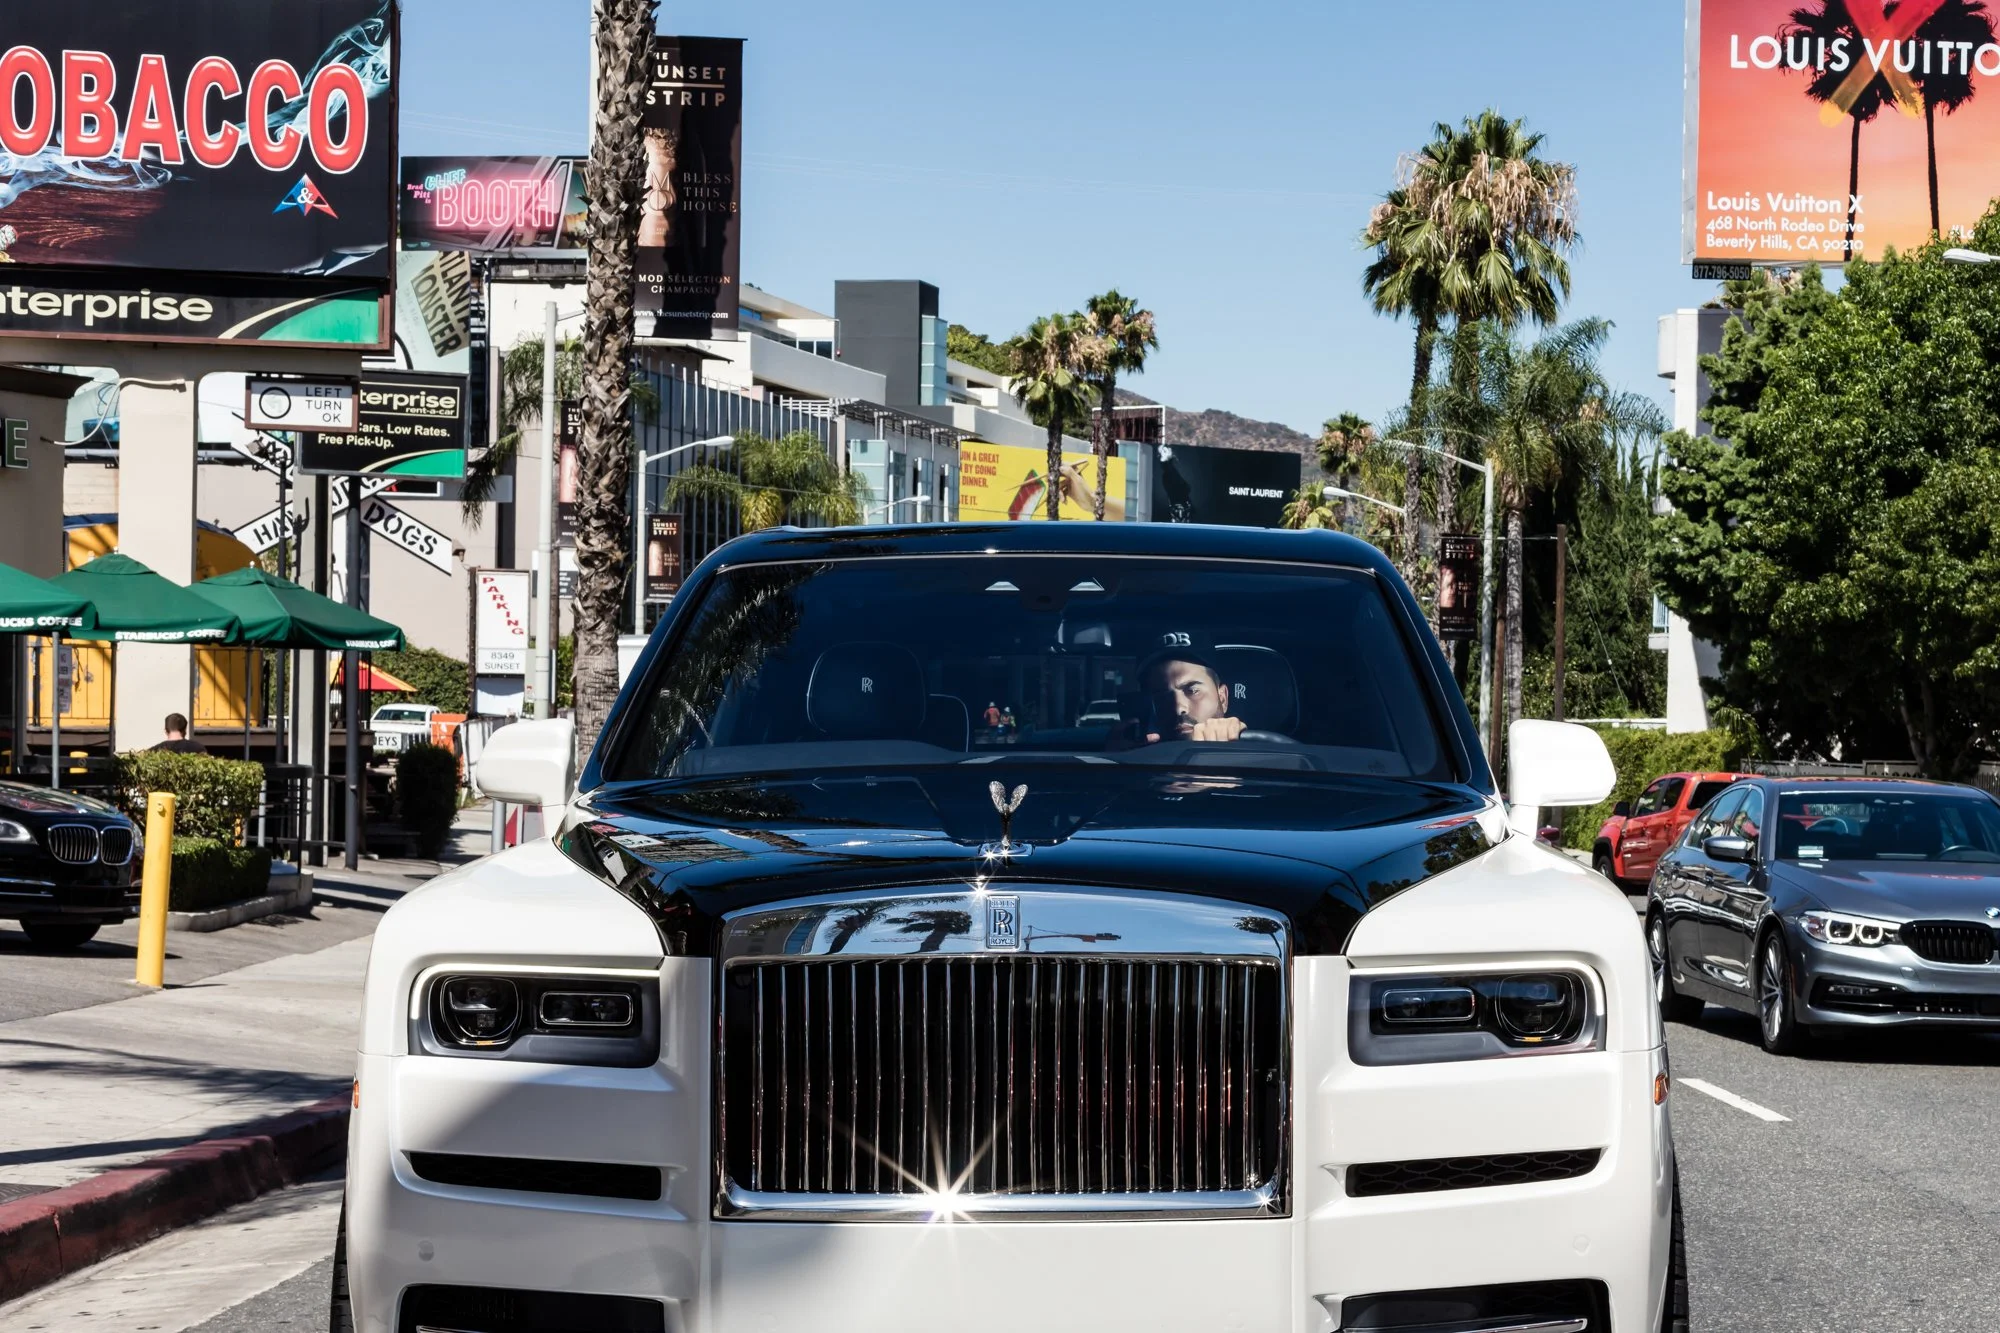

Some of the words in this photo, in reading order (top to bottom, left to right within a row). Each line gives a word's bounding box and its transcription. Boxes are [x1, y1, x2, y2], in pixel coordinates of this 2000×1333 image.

[653, 52, 669, 60] HE
[1730, 34, 1850, 72] LOUIS
[1862, 38, 2000, 76] VUITTO
[657, 65, 726, 80] UNSET
[646, 90, 725, 106] STRIP
[0, 45, 368, 174] OBACCO
[424, 168, 467, 191] CLIFF
[683, 172, 732, 184] BLESS
[413, 190, 431, 199] Pitt
[683, 186, 721, 197] THIS
[436, 180, 555, 227] BOOTH
[683, 200, 737, 212] HOUSE
[1706, 191, 1761, 212] Louis
[1767, 192, 1842, 213] Vuitton
[1848, 194, 1864, 214] X
[1706, 215, 1733, 234] 468
[1736, 216, 1777, 231] North
[1781, 217, 1825, 233] Rodeo
[1829, 219, 1865, 233] Drive
[1706, 233, 1757, 252] Beverly
[1760, 235, 1792, 251] Hills,
[1796, 236, 1819, 250] CA
[1822, 239, 1864, 253] 90210
[1693, 264, 1750, 280] 877-796-5050
[638, 274, 664, 283] MOD
[650, 285, 718, 295] CHAMPAGNE
[305, 386, 343, 398] LEFT
[307, 400, 342, 410] TURN
[322, 412, 341, 423] OK
[405, 407, 455, 416] rent-a-car
[387, 423, 412, 435] Low
[414, 424, 450, 437] Rates.
[318, 433, 344, 445] Free
[346, 434, 394, 449] Pick-Up.
[978, 453, 999, 464] GREAT
[975, 465, 997, 476] GOING
[1229, 486, 1250, 496] SAINT
[1250, 488, 1284, 498] LAURENT
[960, 495, 969, 505] TE
[363, 502, 438, 556] DOGS
[482, 577, 524, 635] PARKING
[37, 616, 83, 626] COFFEE
[115, 631, 185, 640] STARBUCKS
[187, 629, 227, 638] COFFEE
[491, 652, 515, 660] 8349
[484, 662, 520, 670] SUNSET
